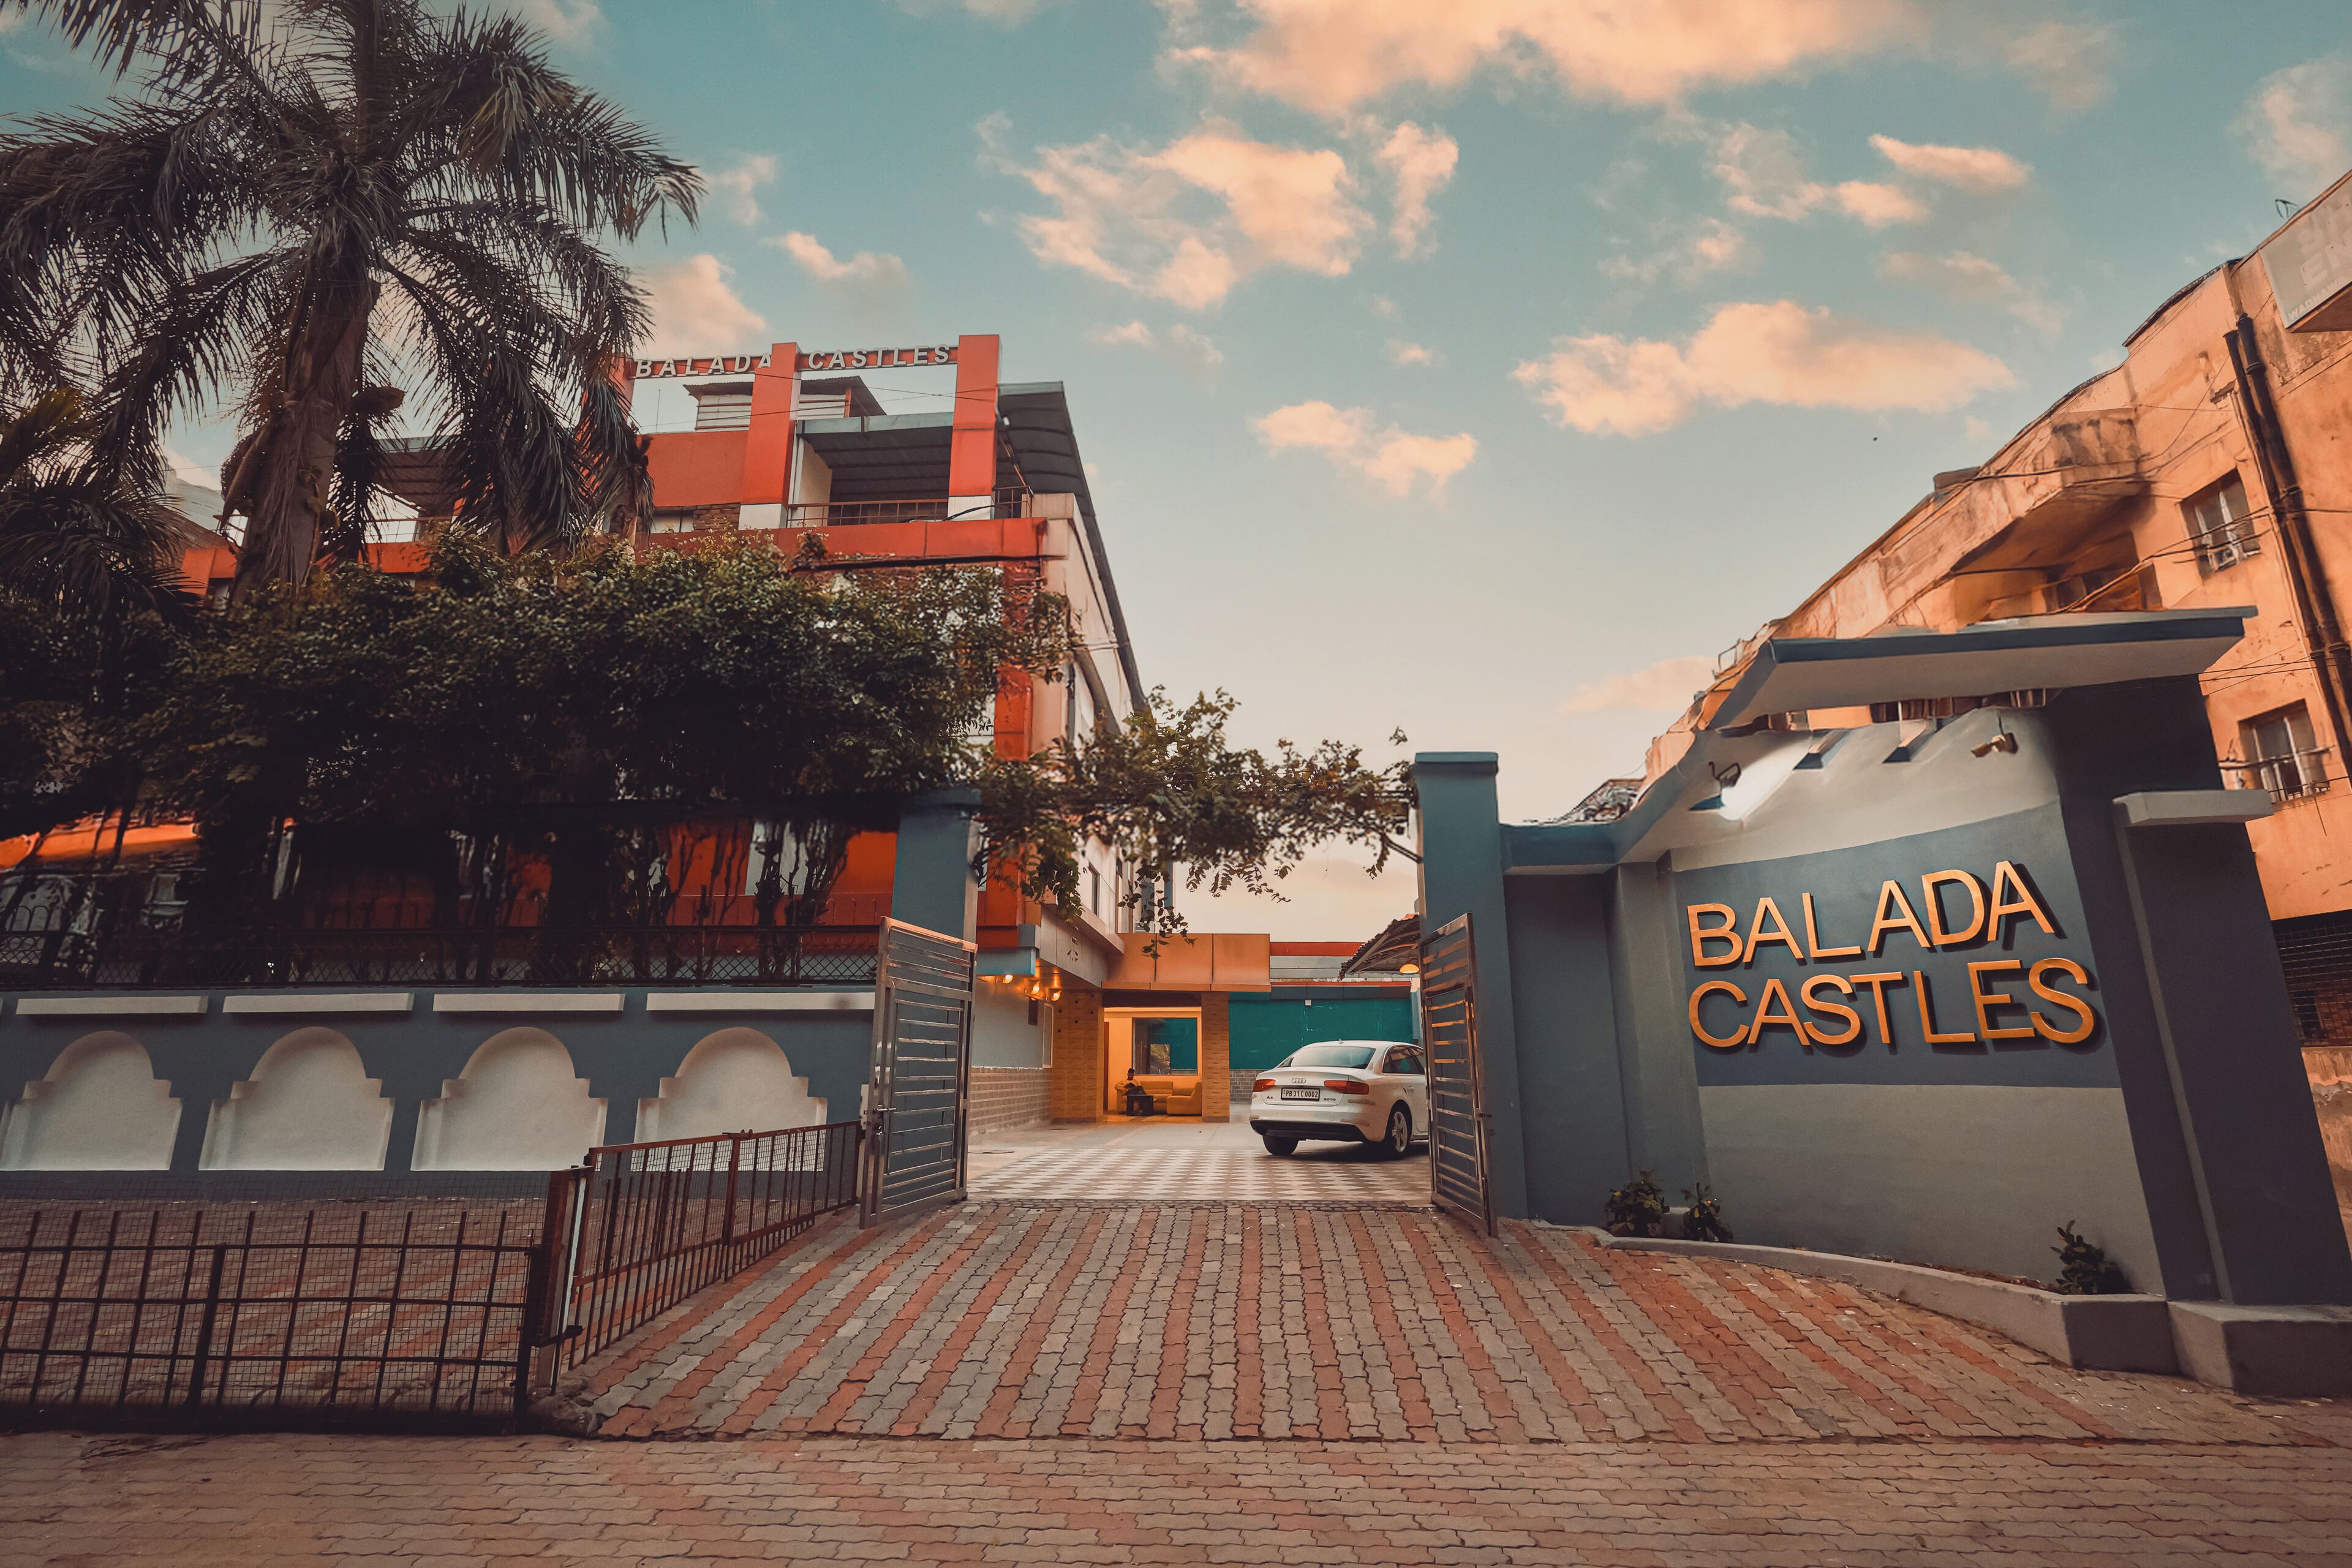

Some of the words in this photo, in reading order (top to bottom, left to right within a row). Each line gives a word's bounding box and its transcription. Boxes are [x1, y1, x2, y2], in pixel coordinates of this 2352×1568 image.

[636, 353, 772, 377] BALADA
[808, 344, 951, 370] CASTLES
[1687, 859, 2057, 968] BALADA
[1688, 957, 2097, 1048] CASTLES
